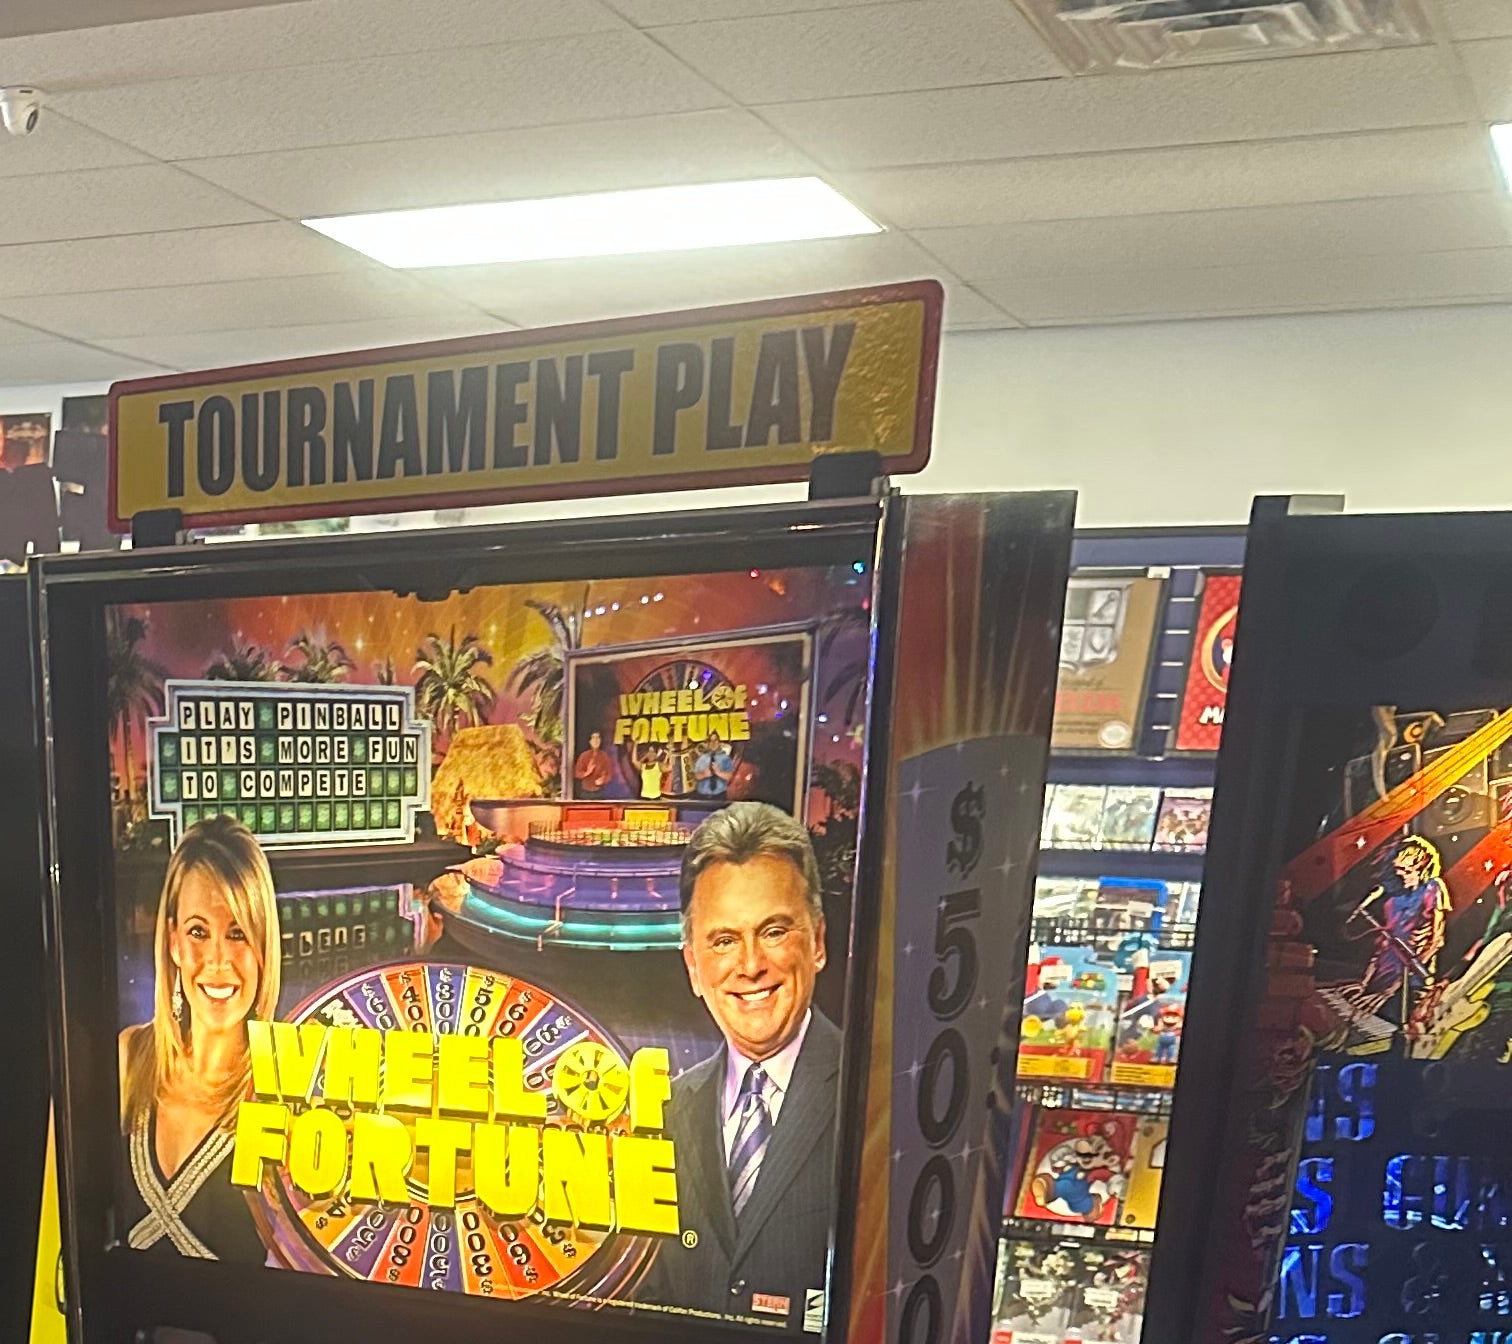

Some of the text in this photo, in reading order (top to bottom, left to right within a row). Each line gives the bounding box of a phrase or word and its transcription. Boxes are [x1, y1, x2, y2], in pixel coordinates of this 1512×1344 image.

[159, 322, 856, 499] TOURNAMENT PLAY
[183, 703, 400, 727] PLAY PINBALL
[619, 688, 712, 716] WHEEL
[613, 711, 750, 745] FORTUNE
[185, 740, 416, 761] IT'S MORE FUN
[185, 773, 365, 794] TO COMPETE
[248, 1020, 549, 1124] WHEEL
[230, 1101, 681, 1236] FORTUNE
